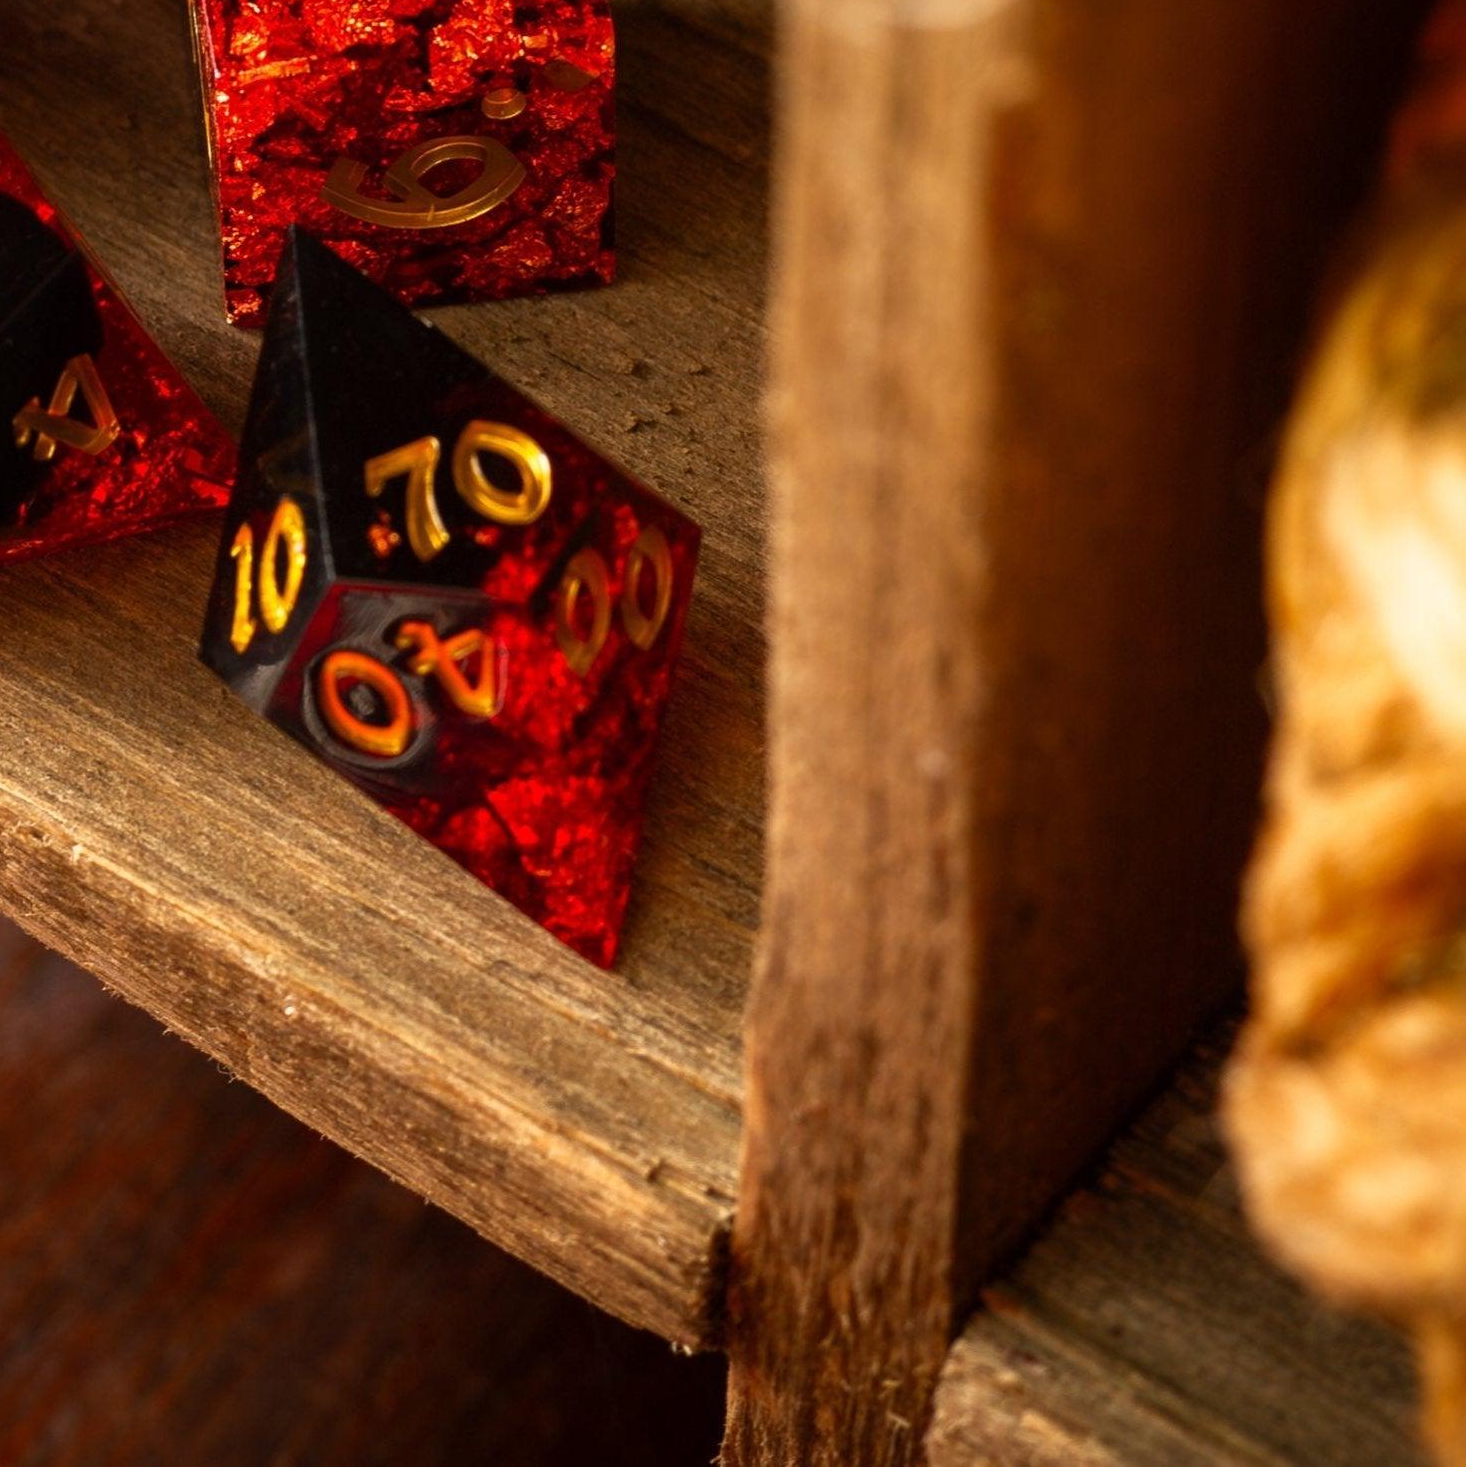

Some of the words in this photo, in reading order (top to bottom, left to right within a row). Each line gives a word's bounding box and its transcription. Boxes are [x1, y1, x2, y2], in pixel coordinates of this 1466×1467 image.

[11, 353, 121, 462] 4
[364, 420, 552, 562] 70
[230, 495, 307, 655] 10
[318, 619, 499, 758] 40
